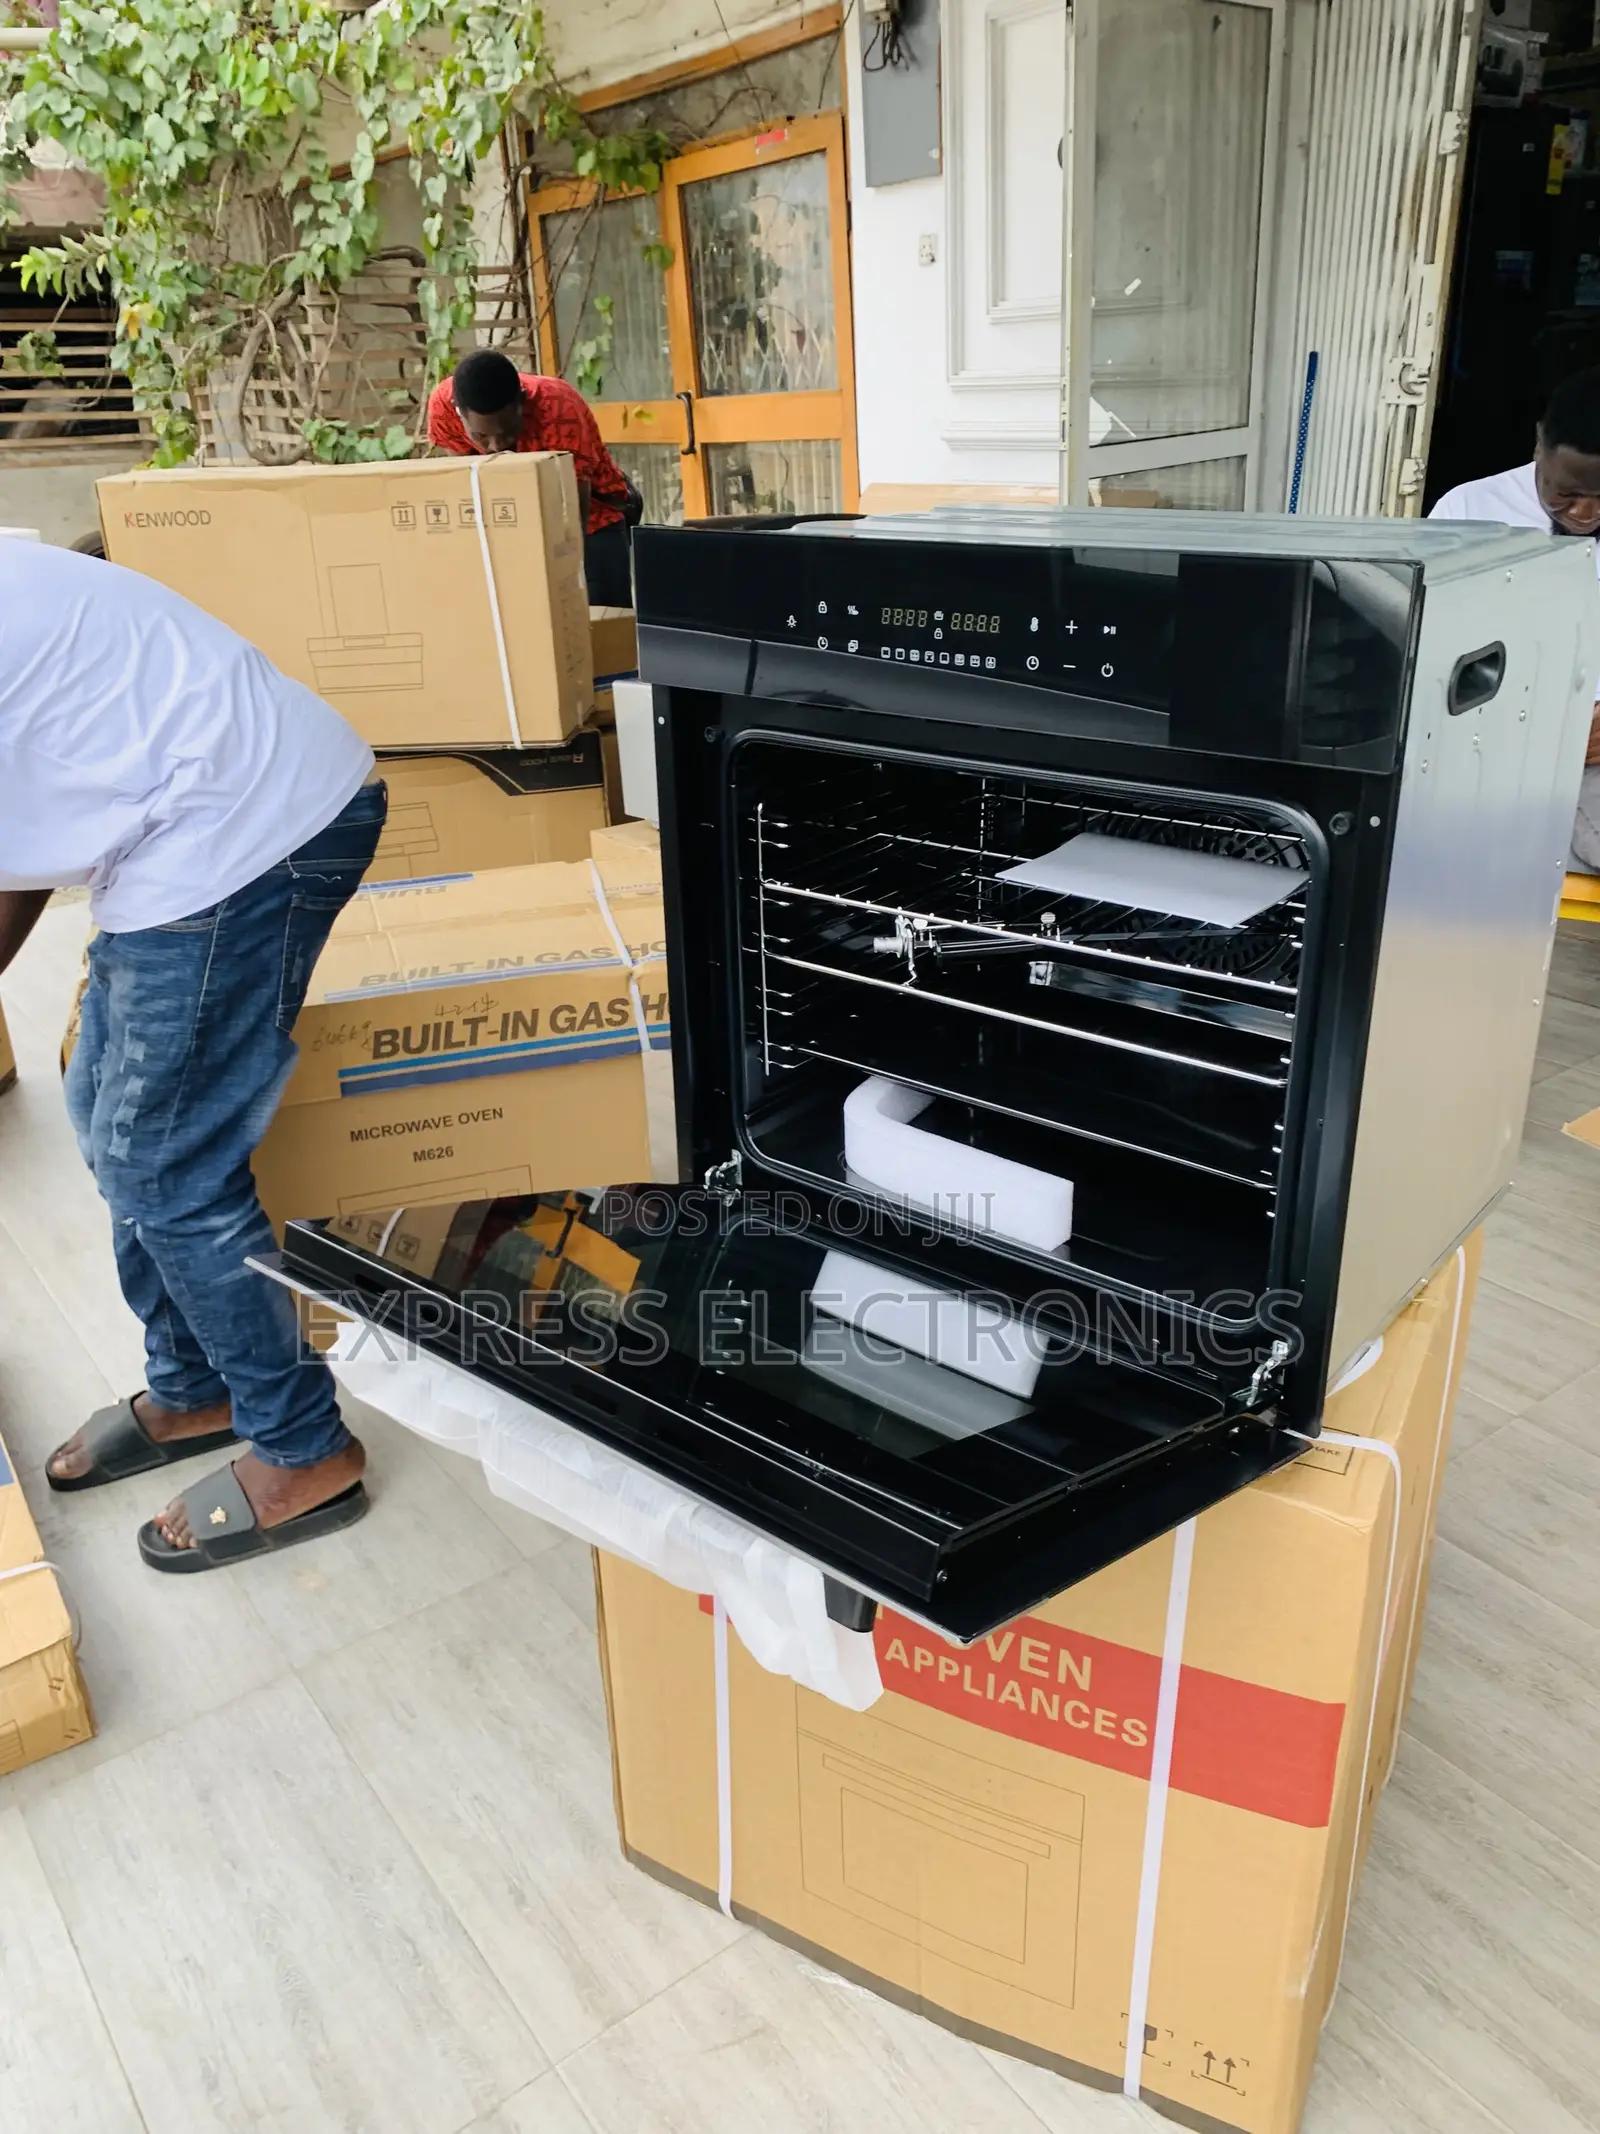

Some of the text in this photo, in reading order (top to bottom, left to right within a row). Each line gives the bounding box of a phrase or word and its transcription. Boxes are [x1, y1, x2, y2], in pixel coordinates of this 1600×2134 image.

[123, 509, 212, 529] KENWOOD
[360, 955, 524, 987] BUILT-IN
[534, 947, 618, 963] GAS
[371, 1008, 540, 1060] BUILT-IN
[549, 997, 630, 1035] GAS
[350, 1107, 504, 1142] MICROWAVE OVEN
[412, 1145, 454, 1163] M626
[952, 1630, 1092, 1692] VEN
[884, 1637, 1149, 1748] APPLIANCES
